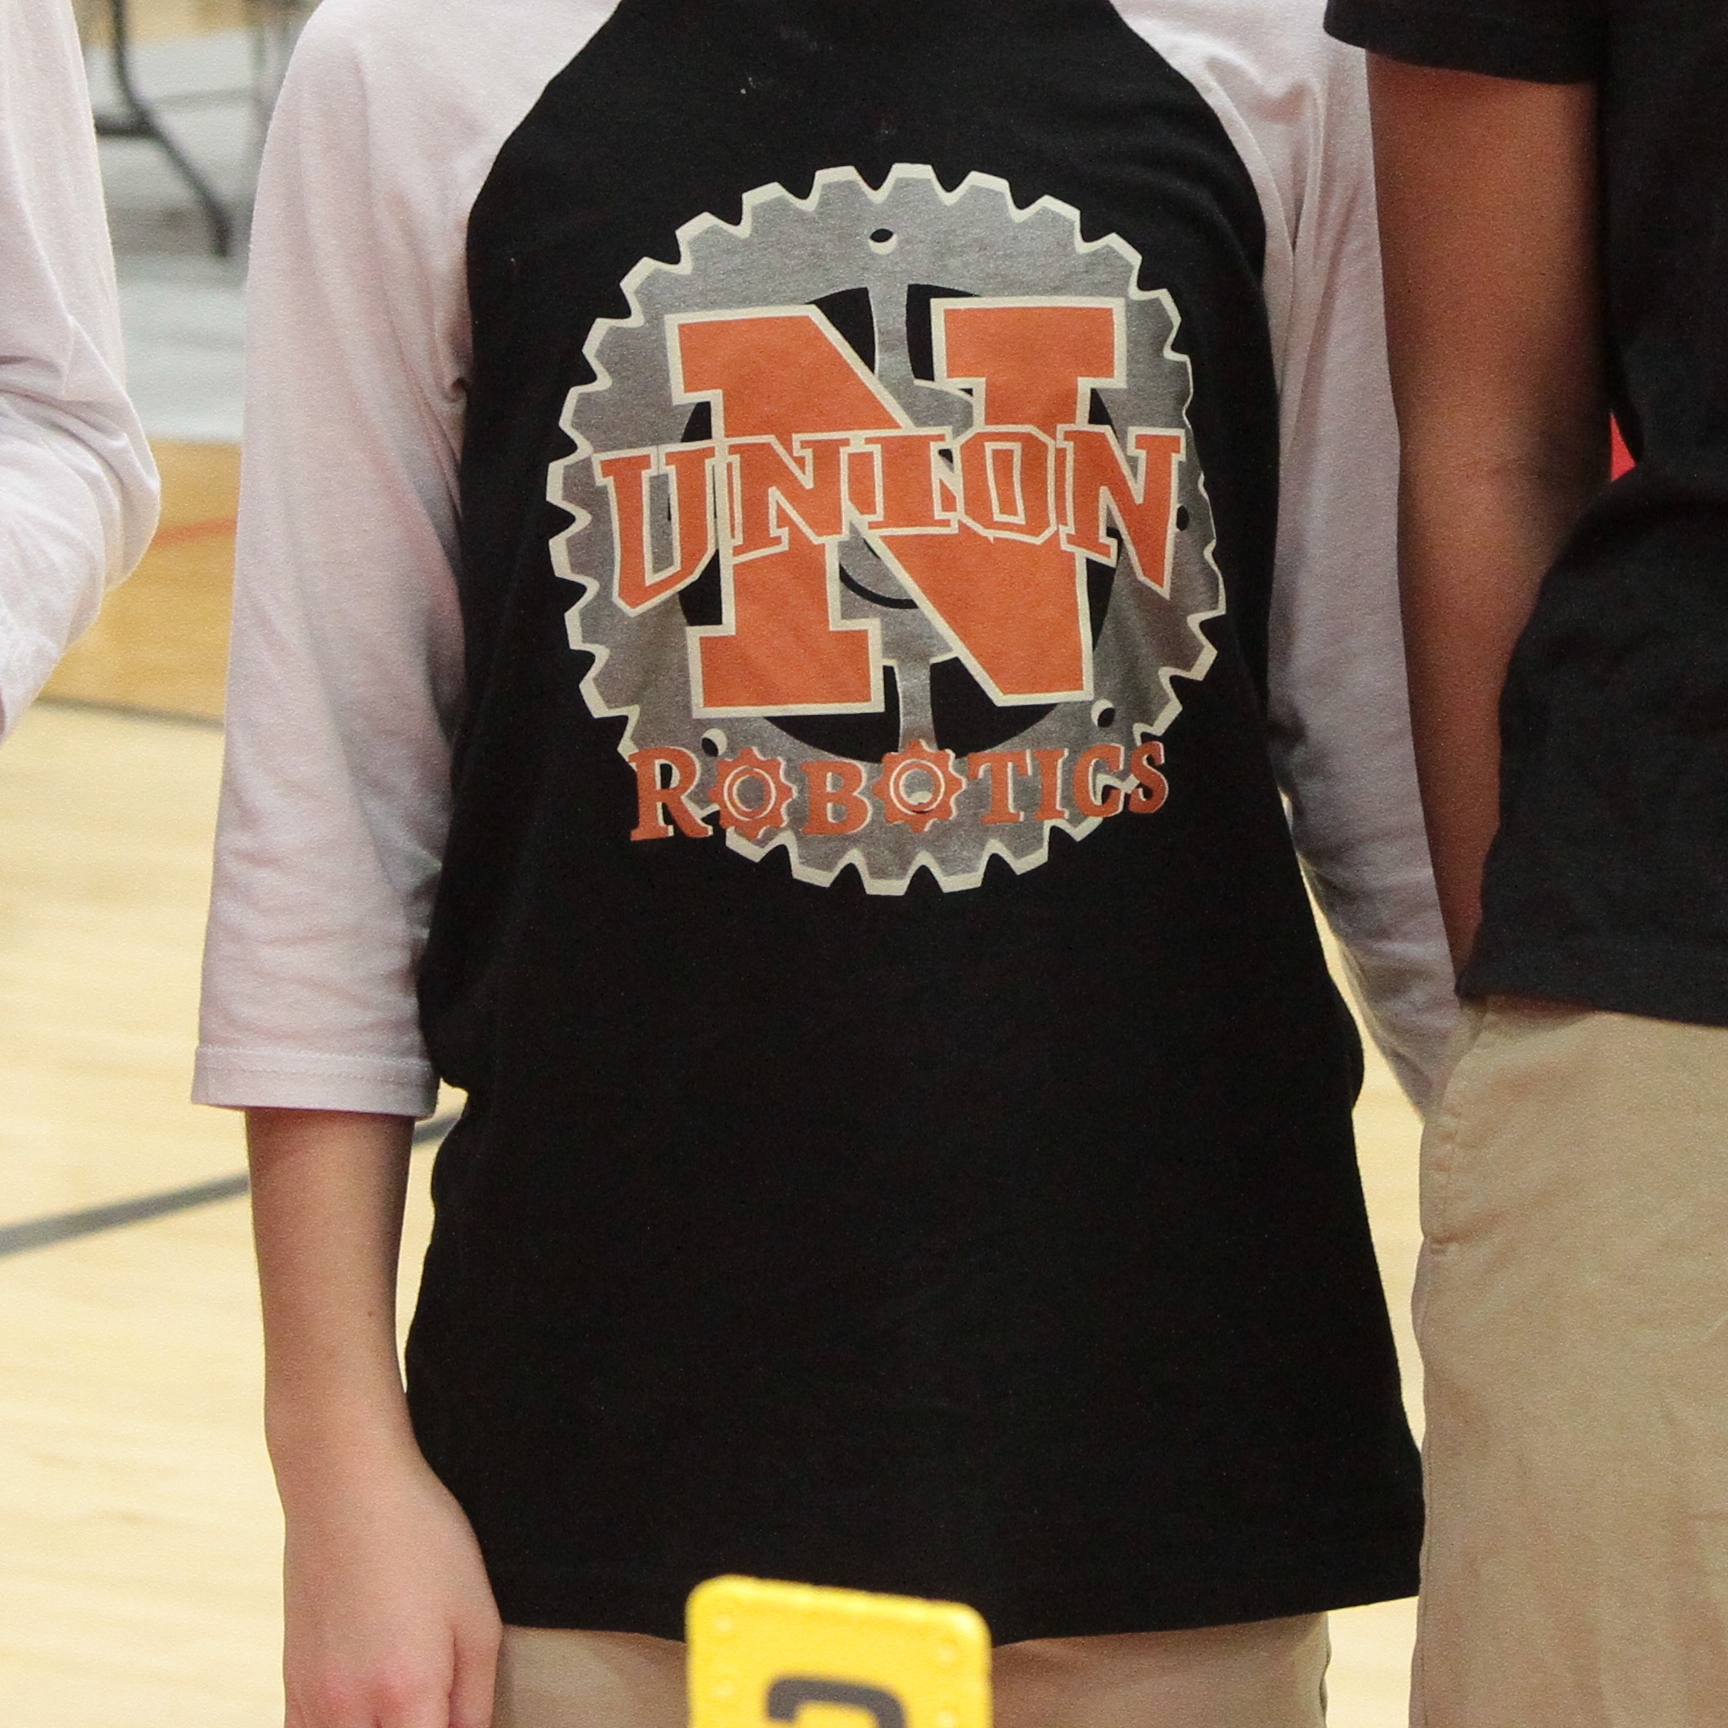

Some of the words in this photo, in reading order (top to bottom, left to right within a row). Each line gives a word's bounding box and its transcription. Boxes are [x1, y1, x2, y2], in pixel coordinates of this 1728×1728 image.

[592, 423, 1185, 618] UNION
[665, 296, 1126, 718] N
[629, 738, 1170, 842] ROBOTICS
